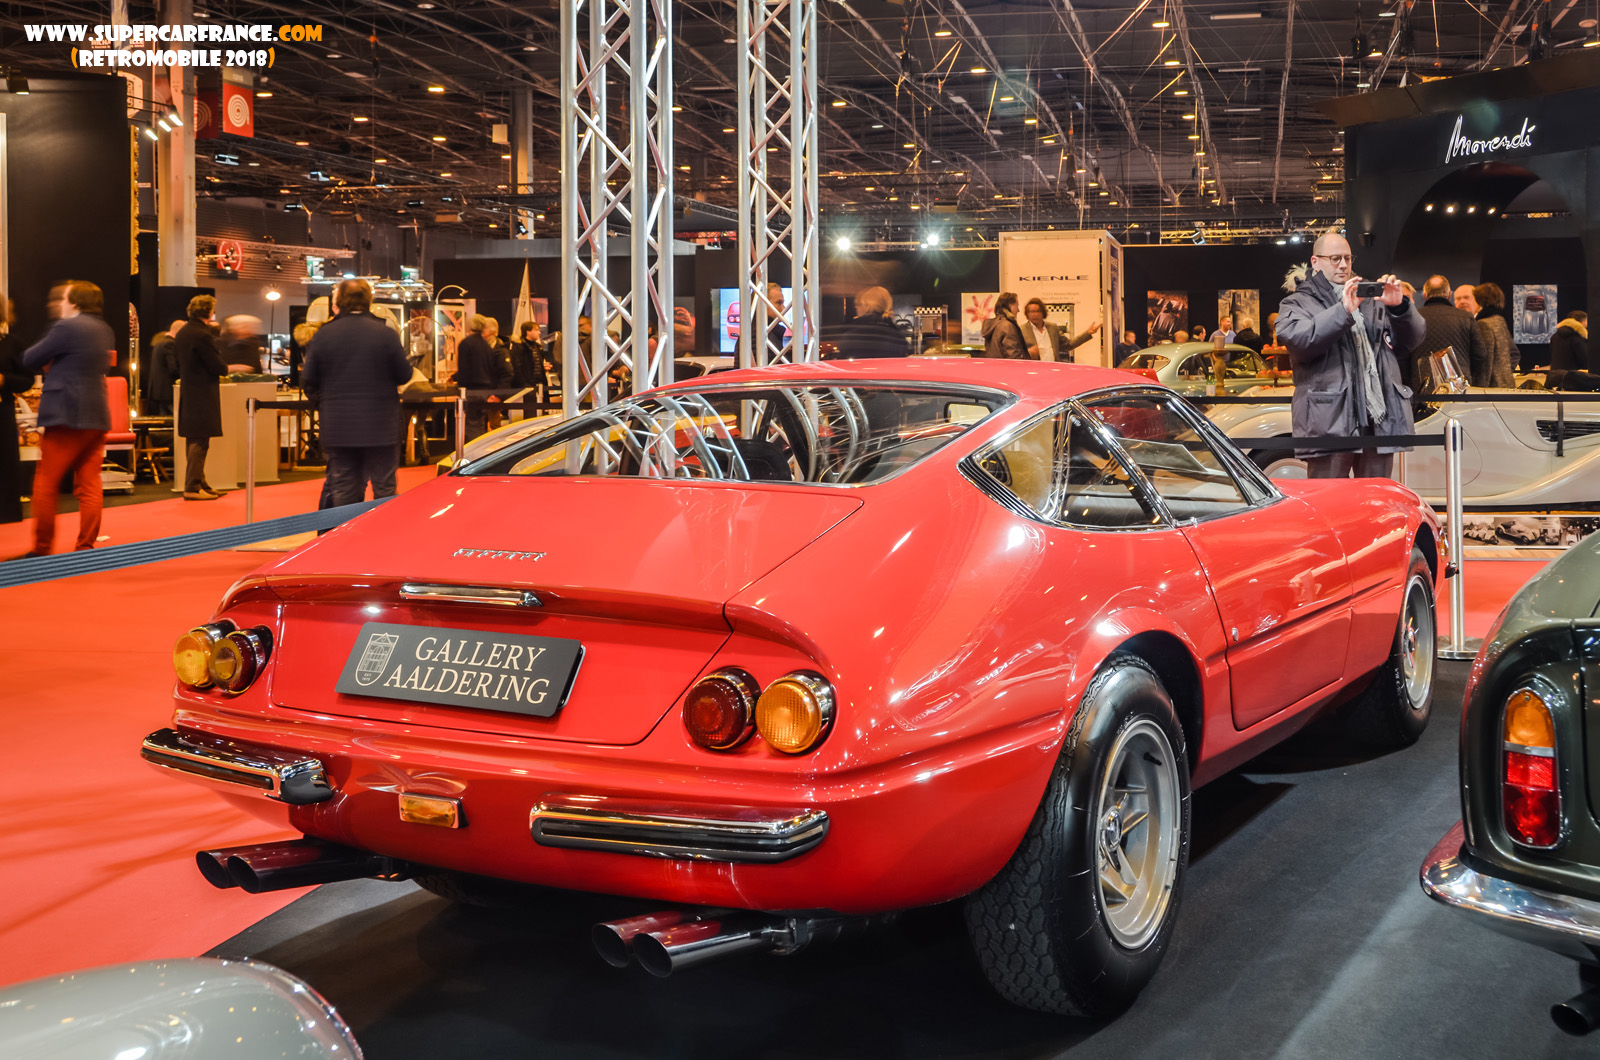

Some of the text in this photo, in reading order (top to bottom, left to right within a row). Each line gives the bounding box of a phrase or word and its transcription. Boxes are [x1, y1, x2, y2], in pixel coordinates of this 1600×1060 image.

[1019, 274, 1089, 282] KIENLE
[415, 637, 546, 672] GALLERY
[383, 664, 550, 704] AALDERING
